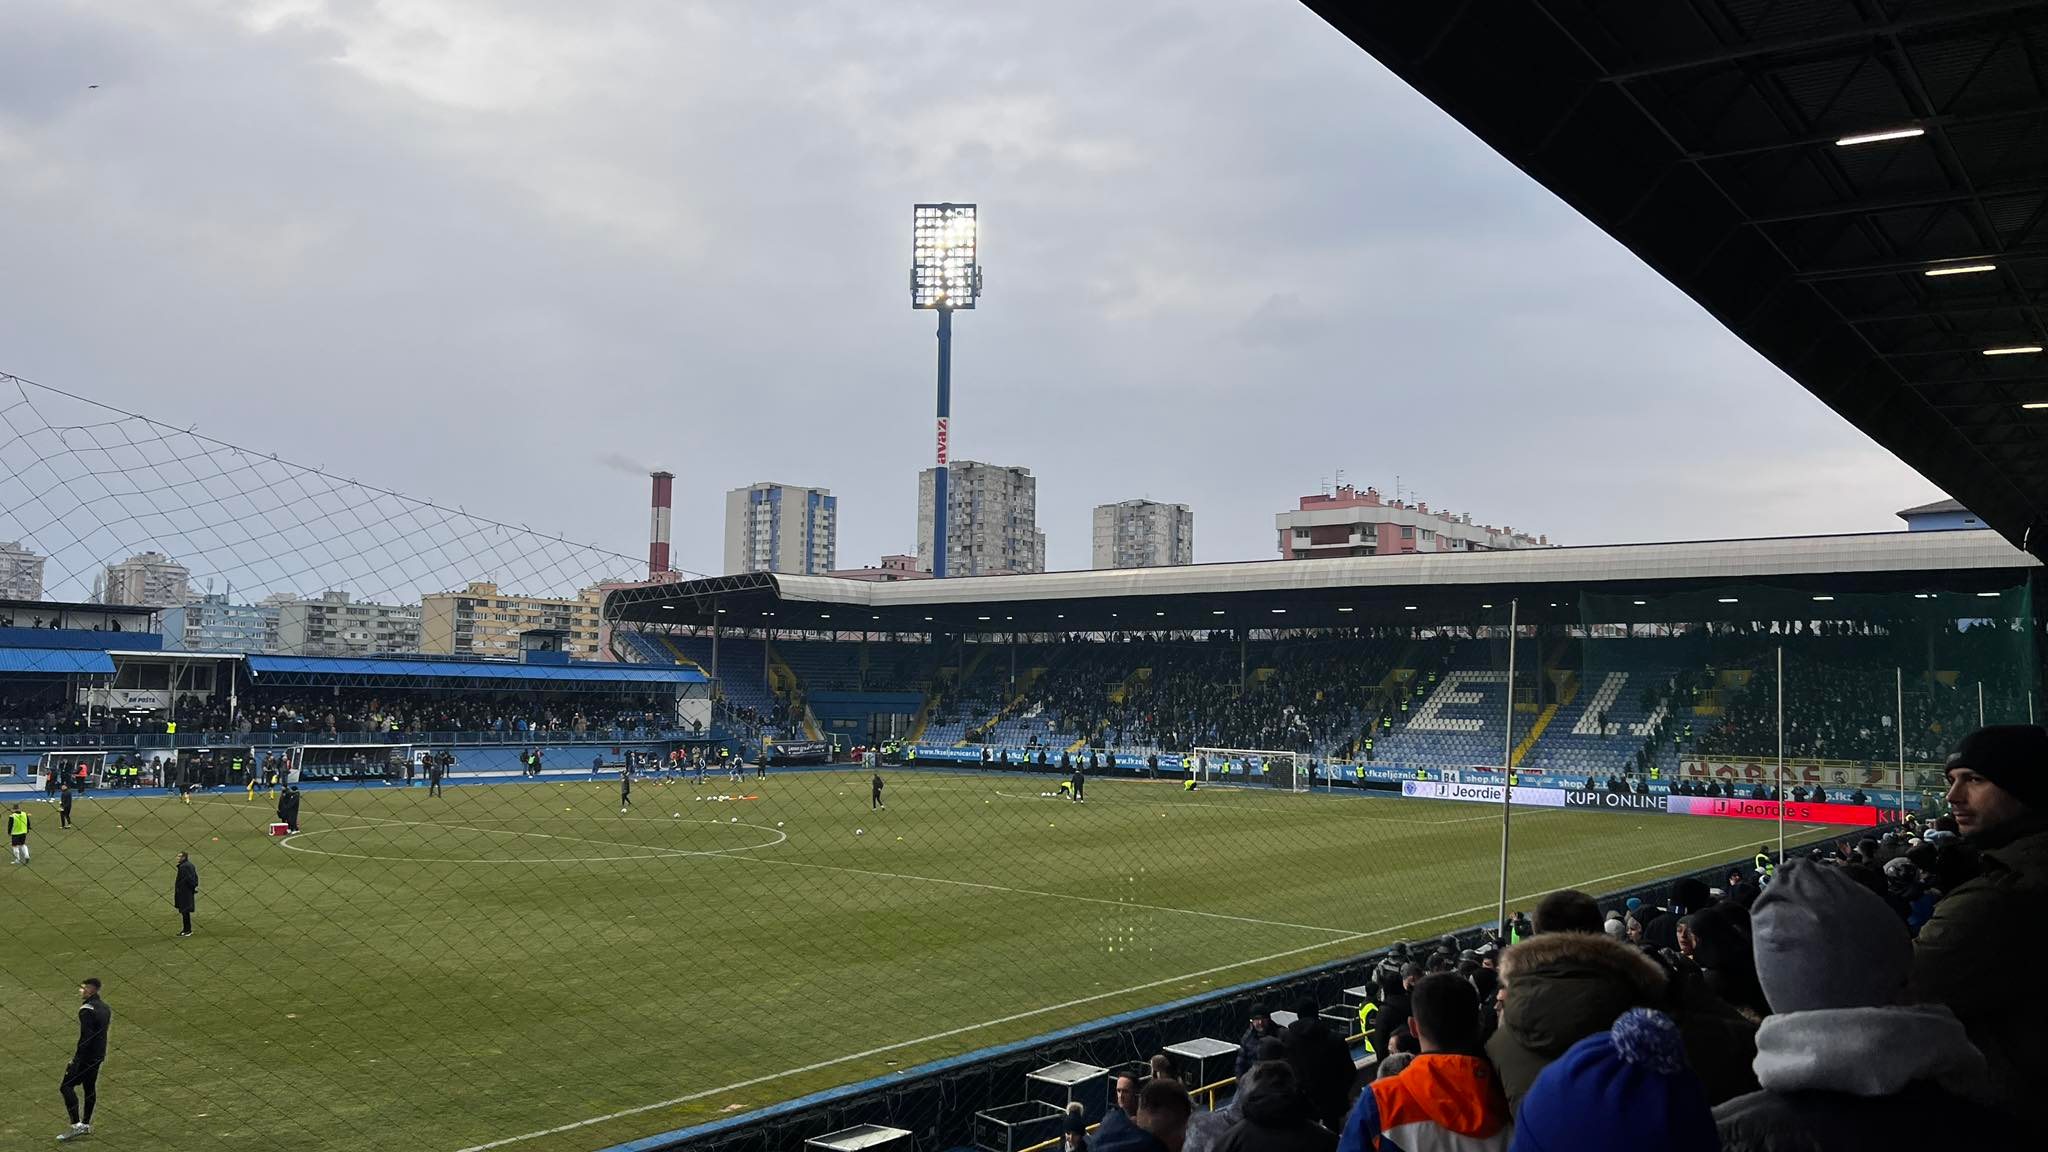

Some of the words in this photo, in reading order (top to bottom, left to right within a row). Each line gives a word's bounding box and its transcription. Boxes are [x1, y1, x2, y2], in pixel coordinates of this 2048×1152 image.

[937, 419, 947, 465] avaz
[1443, 772, 1457, 784] B4
[1566, 791, 1600, 806] KUPI
[1606, 793, 1667, 810] ONLINE
